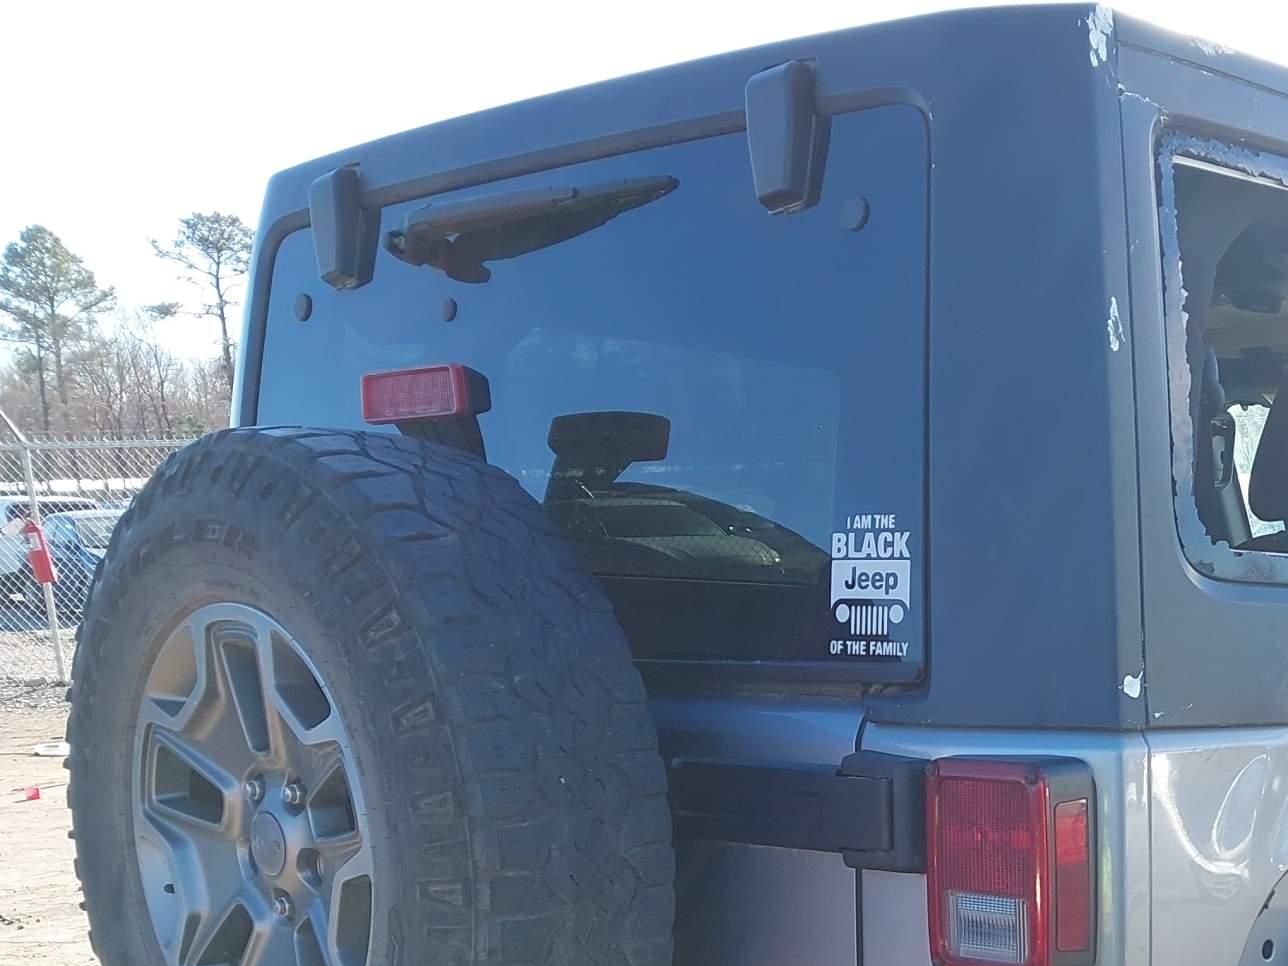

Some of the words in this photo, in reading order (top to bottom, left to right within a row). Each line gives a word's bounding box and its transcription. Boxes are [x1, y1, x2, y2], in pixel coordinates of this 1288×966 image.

[853, 514, 871, 529] AM
[874, 514, 896, 529] THE
[831, 531, 911, 559] BLACK
[844, 566, 899, 595] Jeep
[829, 640, 845, 656] OF
[846, 641, 867, 656] THE
[869, 641, 909, 657] FAMILY
